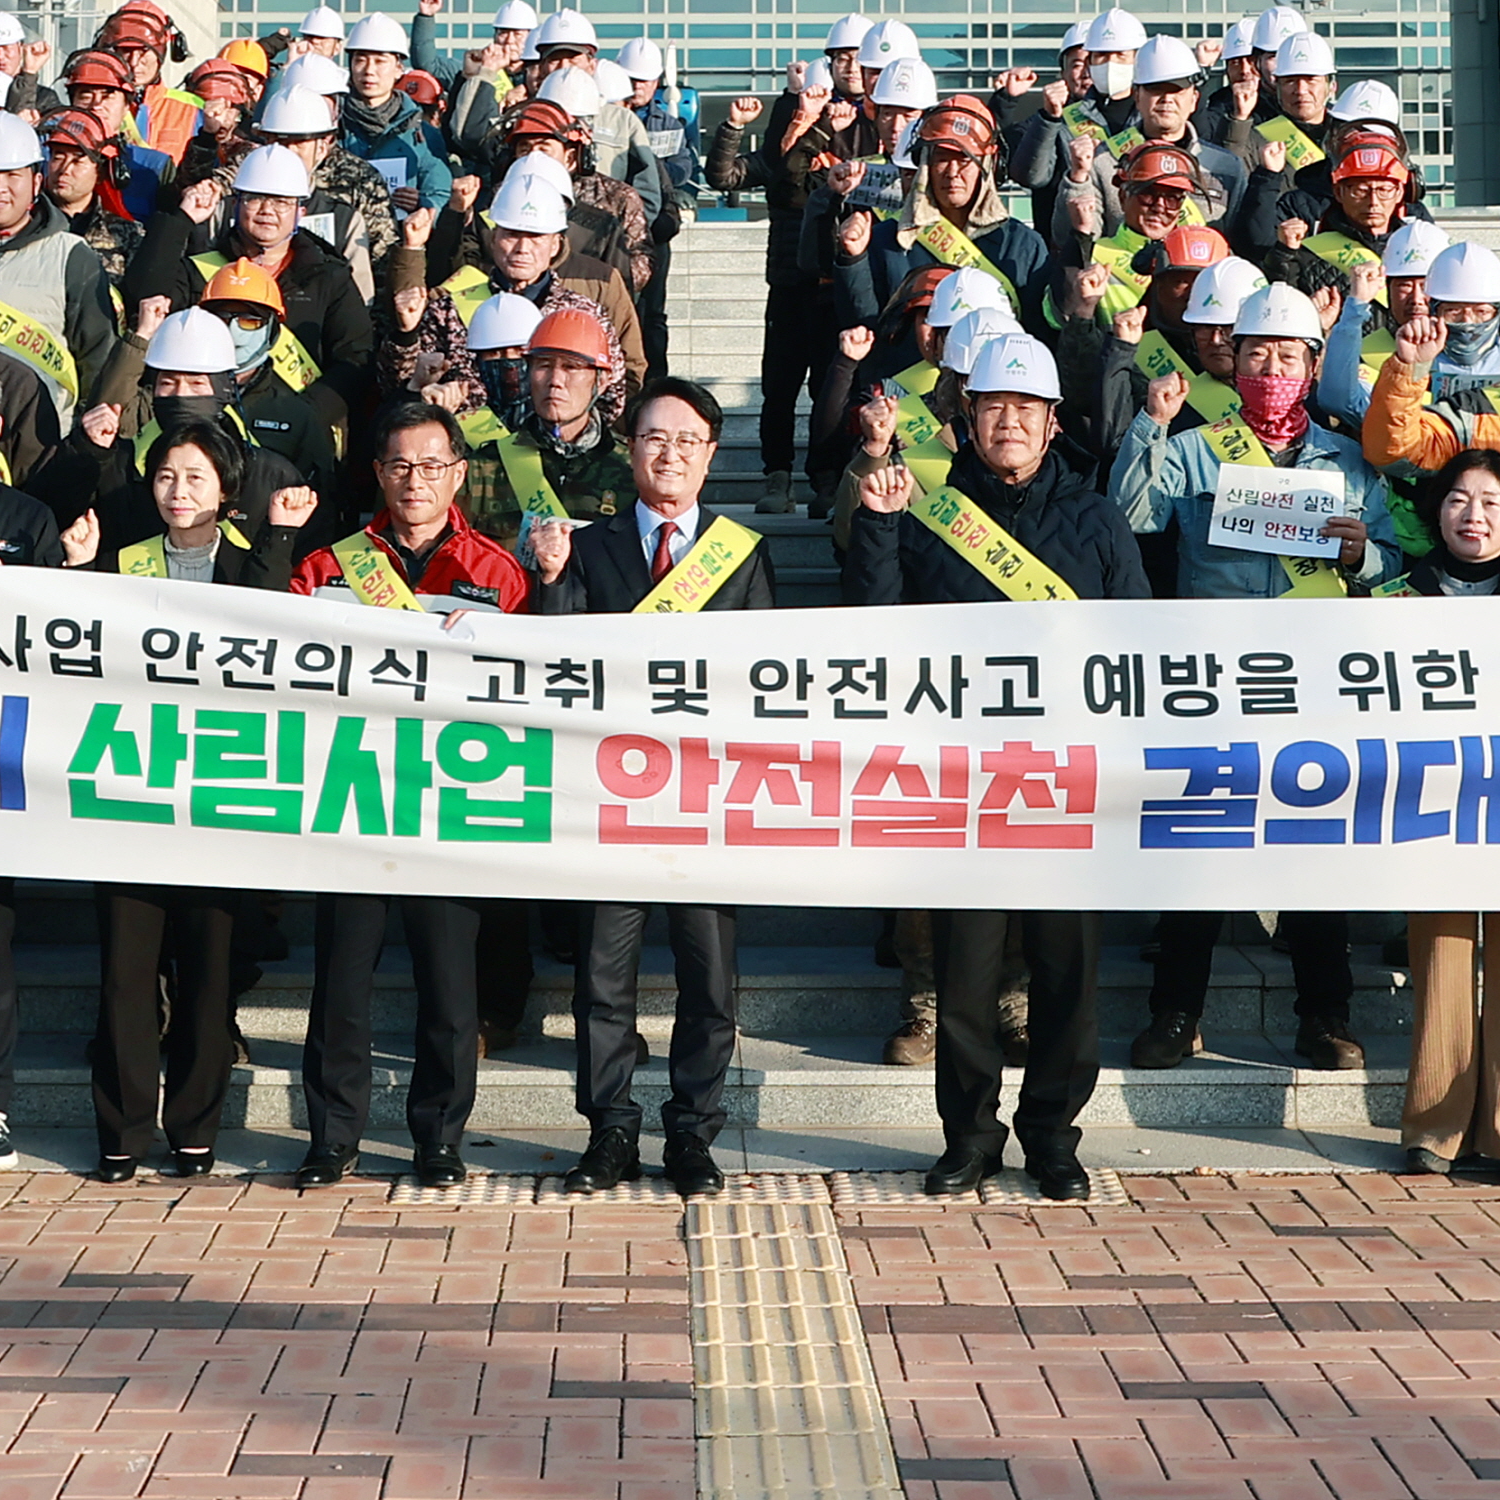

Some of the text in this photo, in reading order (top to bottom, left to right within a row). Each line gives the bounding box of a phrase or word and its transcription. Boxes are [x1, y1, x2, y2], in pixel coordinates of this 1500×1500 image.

[928, 492, 991, 549] 산림안전
[1221, 515, 1255, 535] 나의
[1226, 488, 1334, 514] 산림안전 실천
[348, 546, 399, 608] 산림안전
[673, 541, 734, 604] 산림안전
[140, 627, 429, 701] 안전의식
[466, 653, 605, 711] 고취
[647, 658, 710, 717] 및
[749, 654, 1045, 720] 안전사고
[1083, 651, 1299, 719] 예방을
[1338, 649, 1479, 712] 위한
[68, 702, 554, 844] 산림사업
[596, 732, 1097, 849] 안전실천
